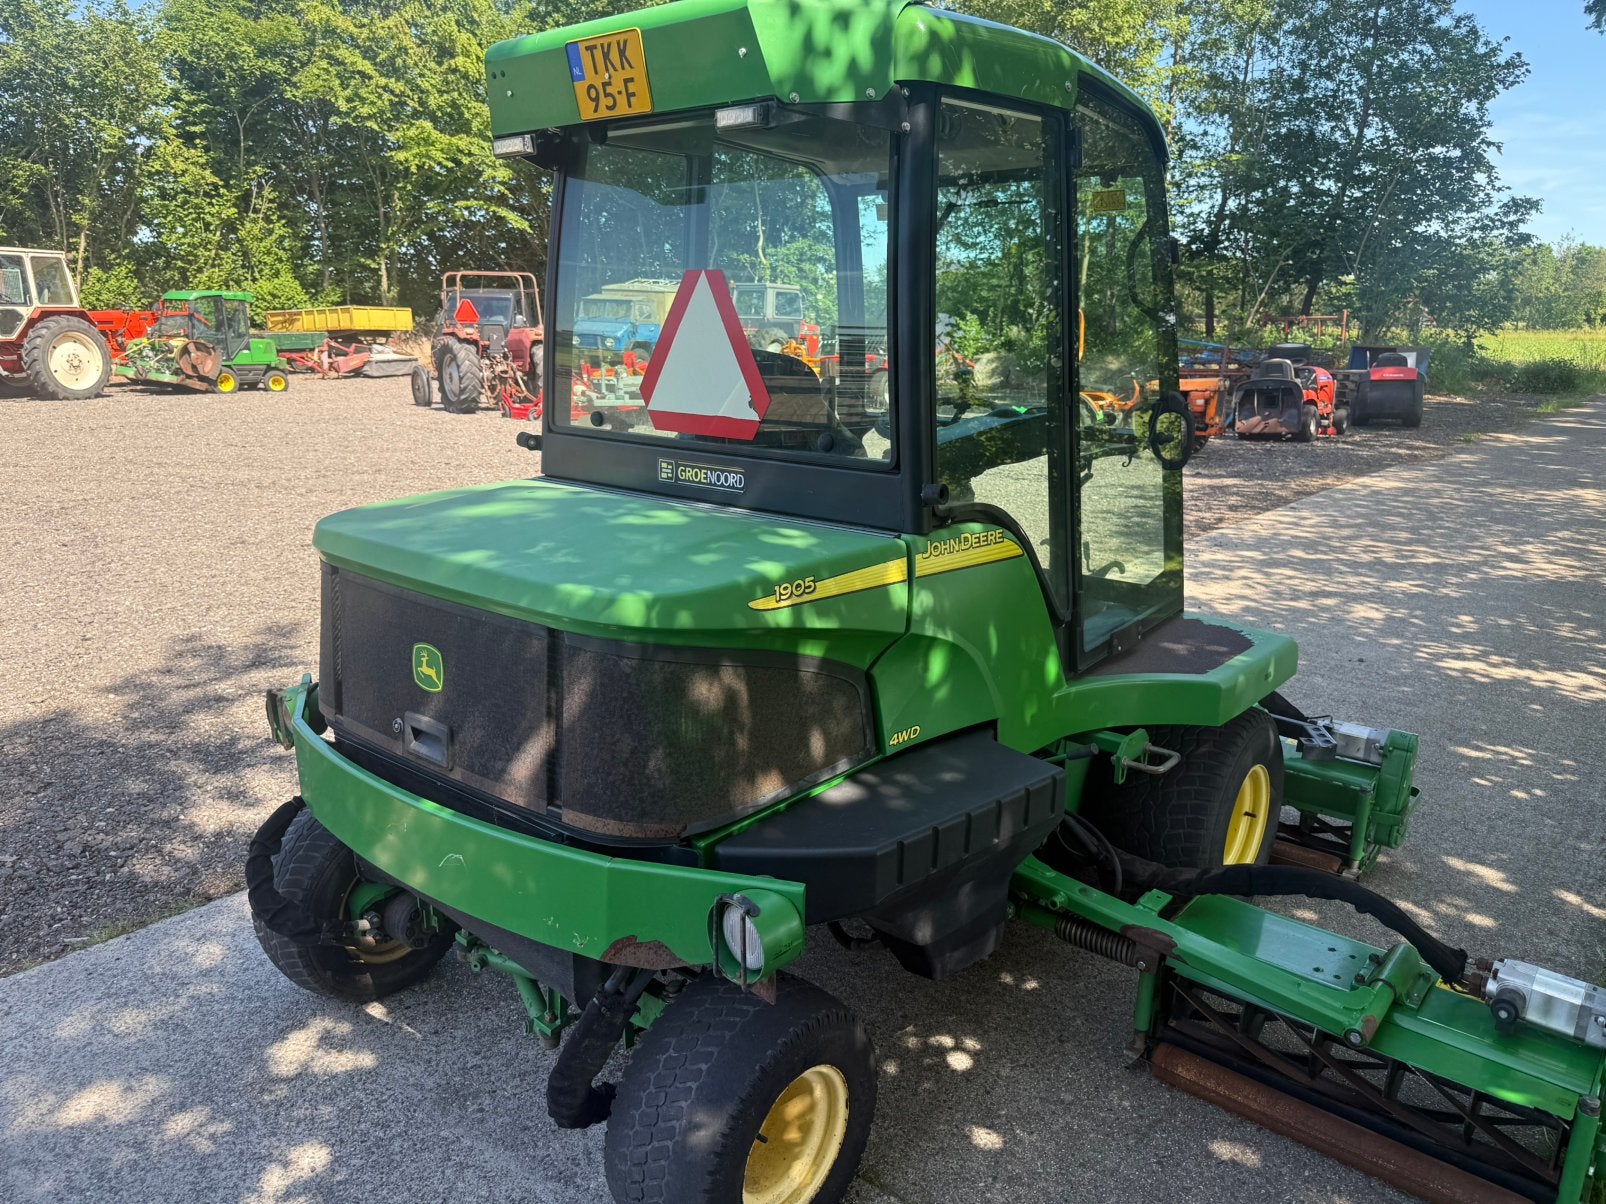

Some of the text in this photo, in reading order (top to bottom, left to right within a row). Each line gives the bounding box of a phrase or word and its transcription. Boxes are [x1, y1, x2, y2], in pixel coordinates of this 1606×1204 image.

[573, 66, 583, 76] NL
[584, 39, 635, 75] TKK
[586, 76, 637, 114] 95-F
[677, 466, 745, 488] GROENOORD
[922, 529, 1005, 559] JOHN DEERE
[774, 575, 816, 603] 1905
[889, 725, 921, 746] 4WD
